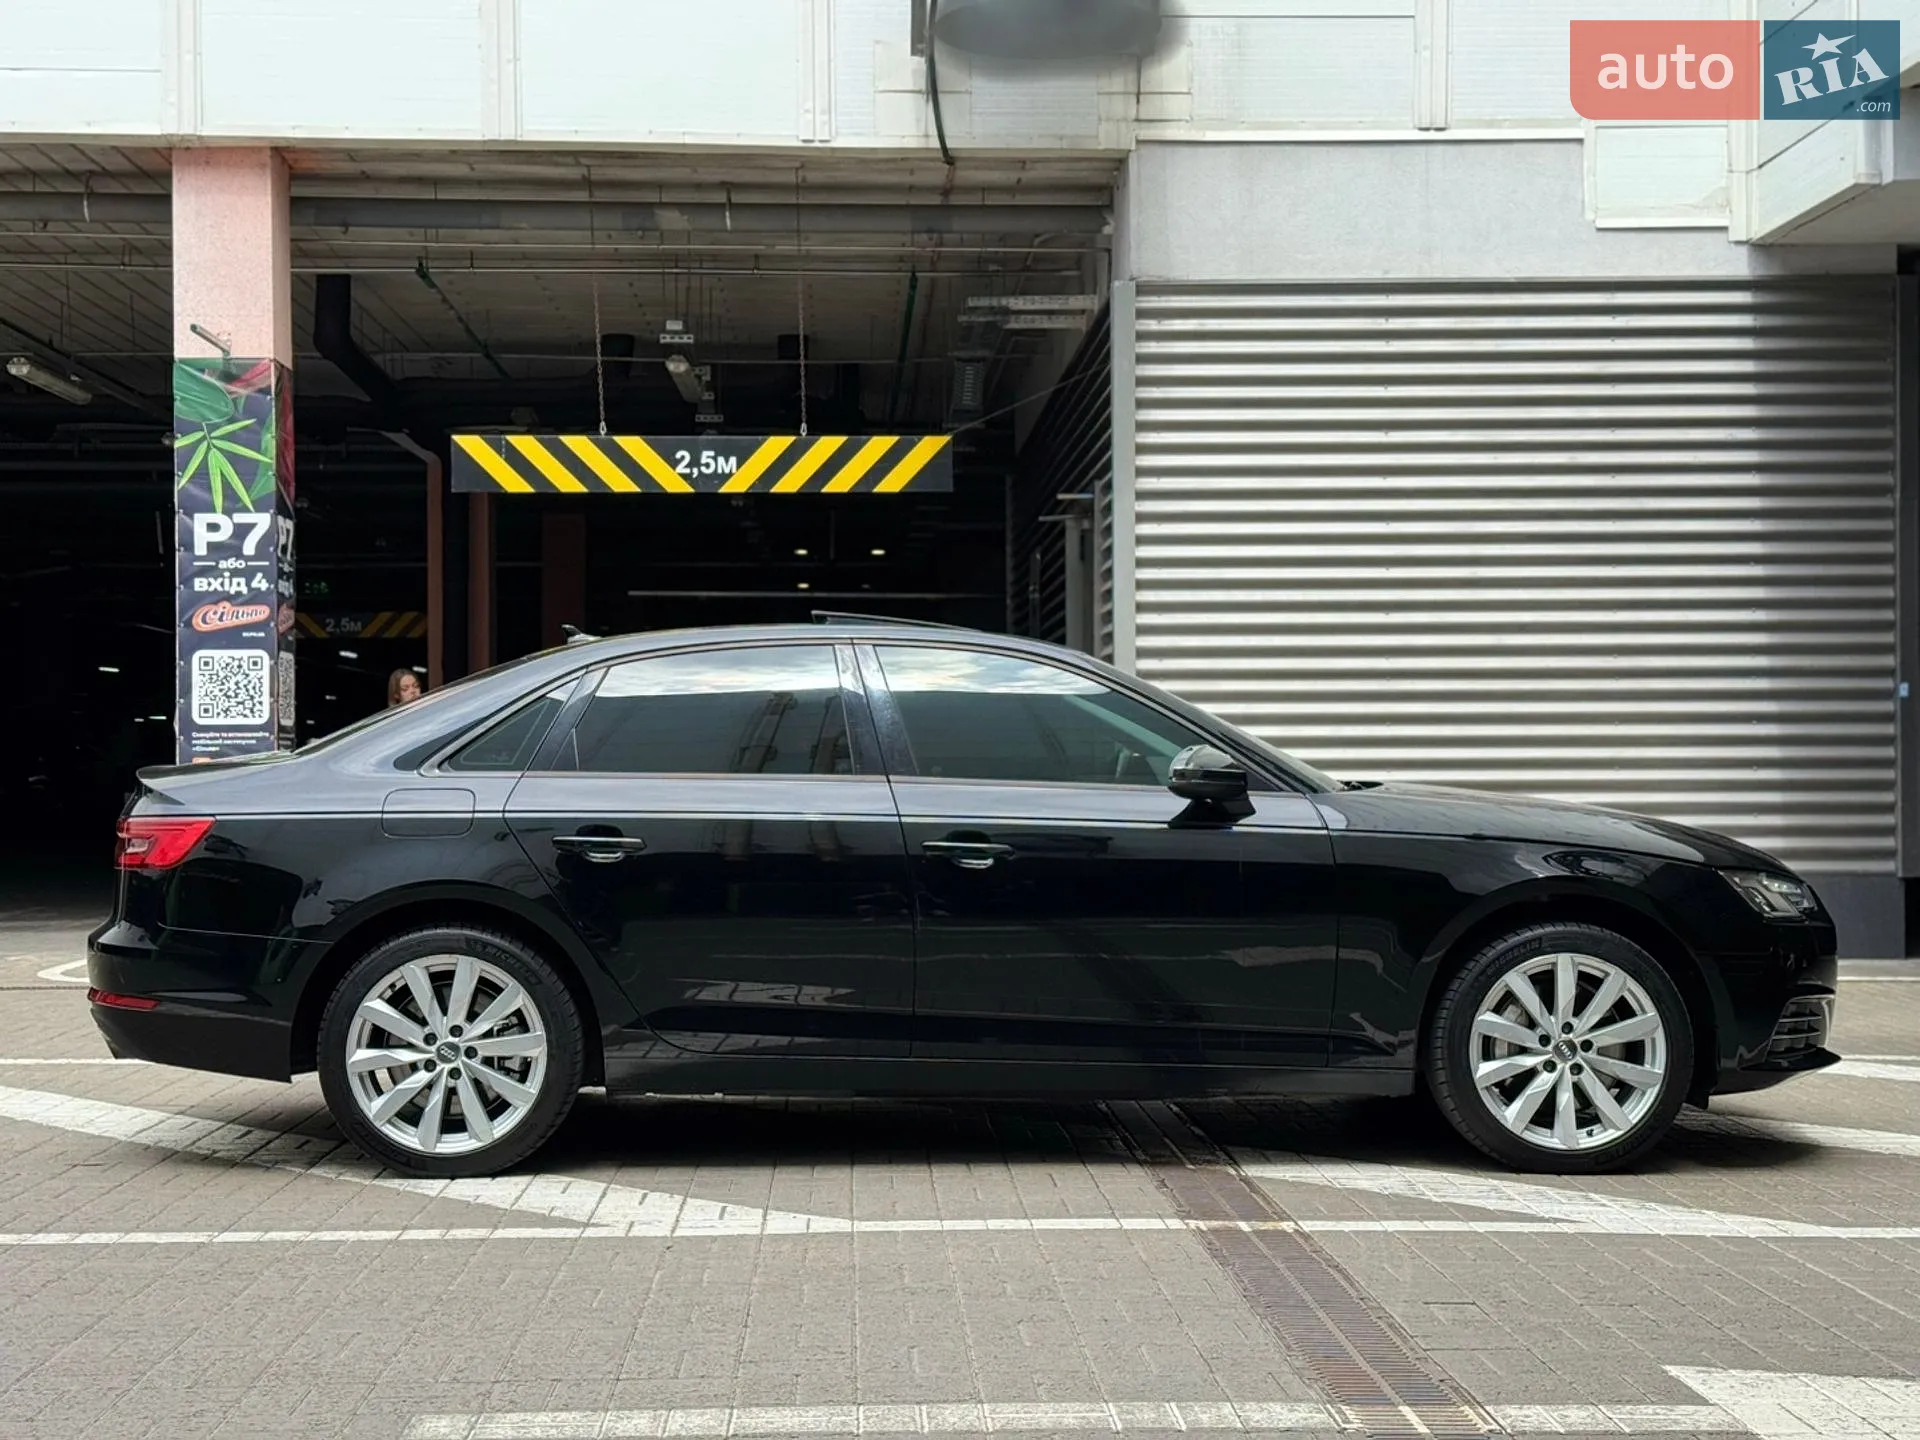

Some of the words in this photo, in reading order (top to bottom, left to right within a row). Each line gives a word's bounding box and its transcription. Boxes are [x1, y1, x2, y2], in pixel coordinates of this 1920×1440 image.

[193, 513, 271, 556] P7
[218, 557, 246, 569] або
[193, 572, 248, 594] вхід
[250, 572, 269, 591] 4
[199, 604, 267, 626] Сільпо
